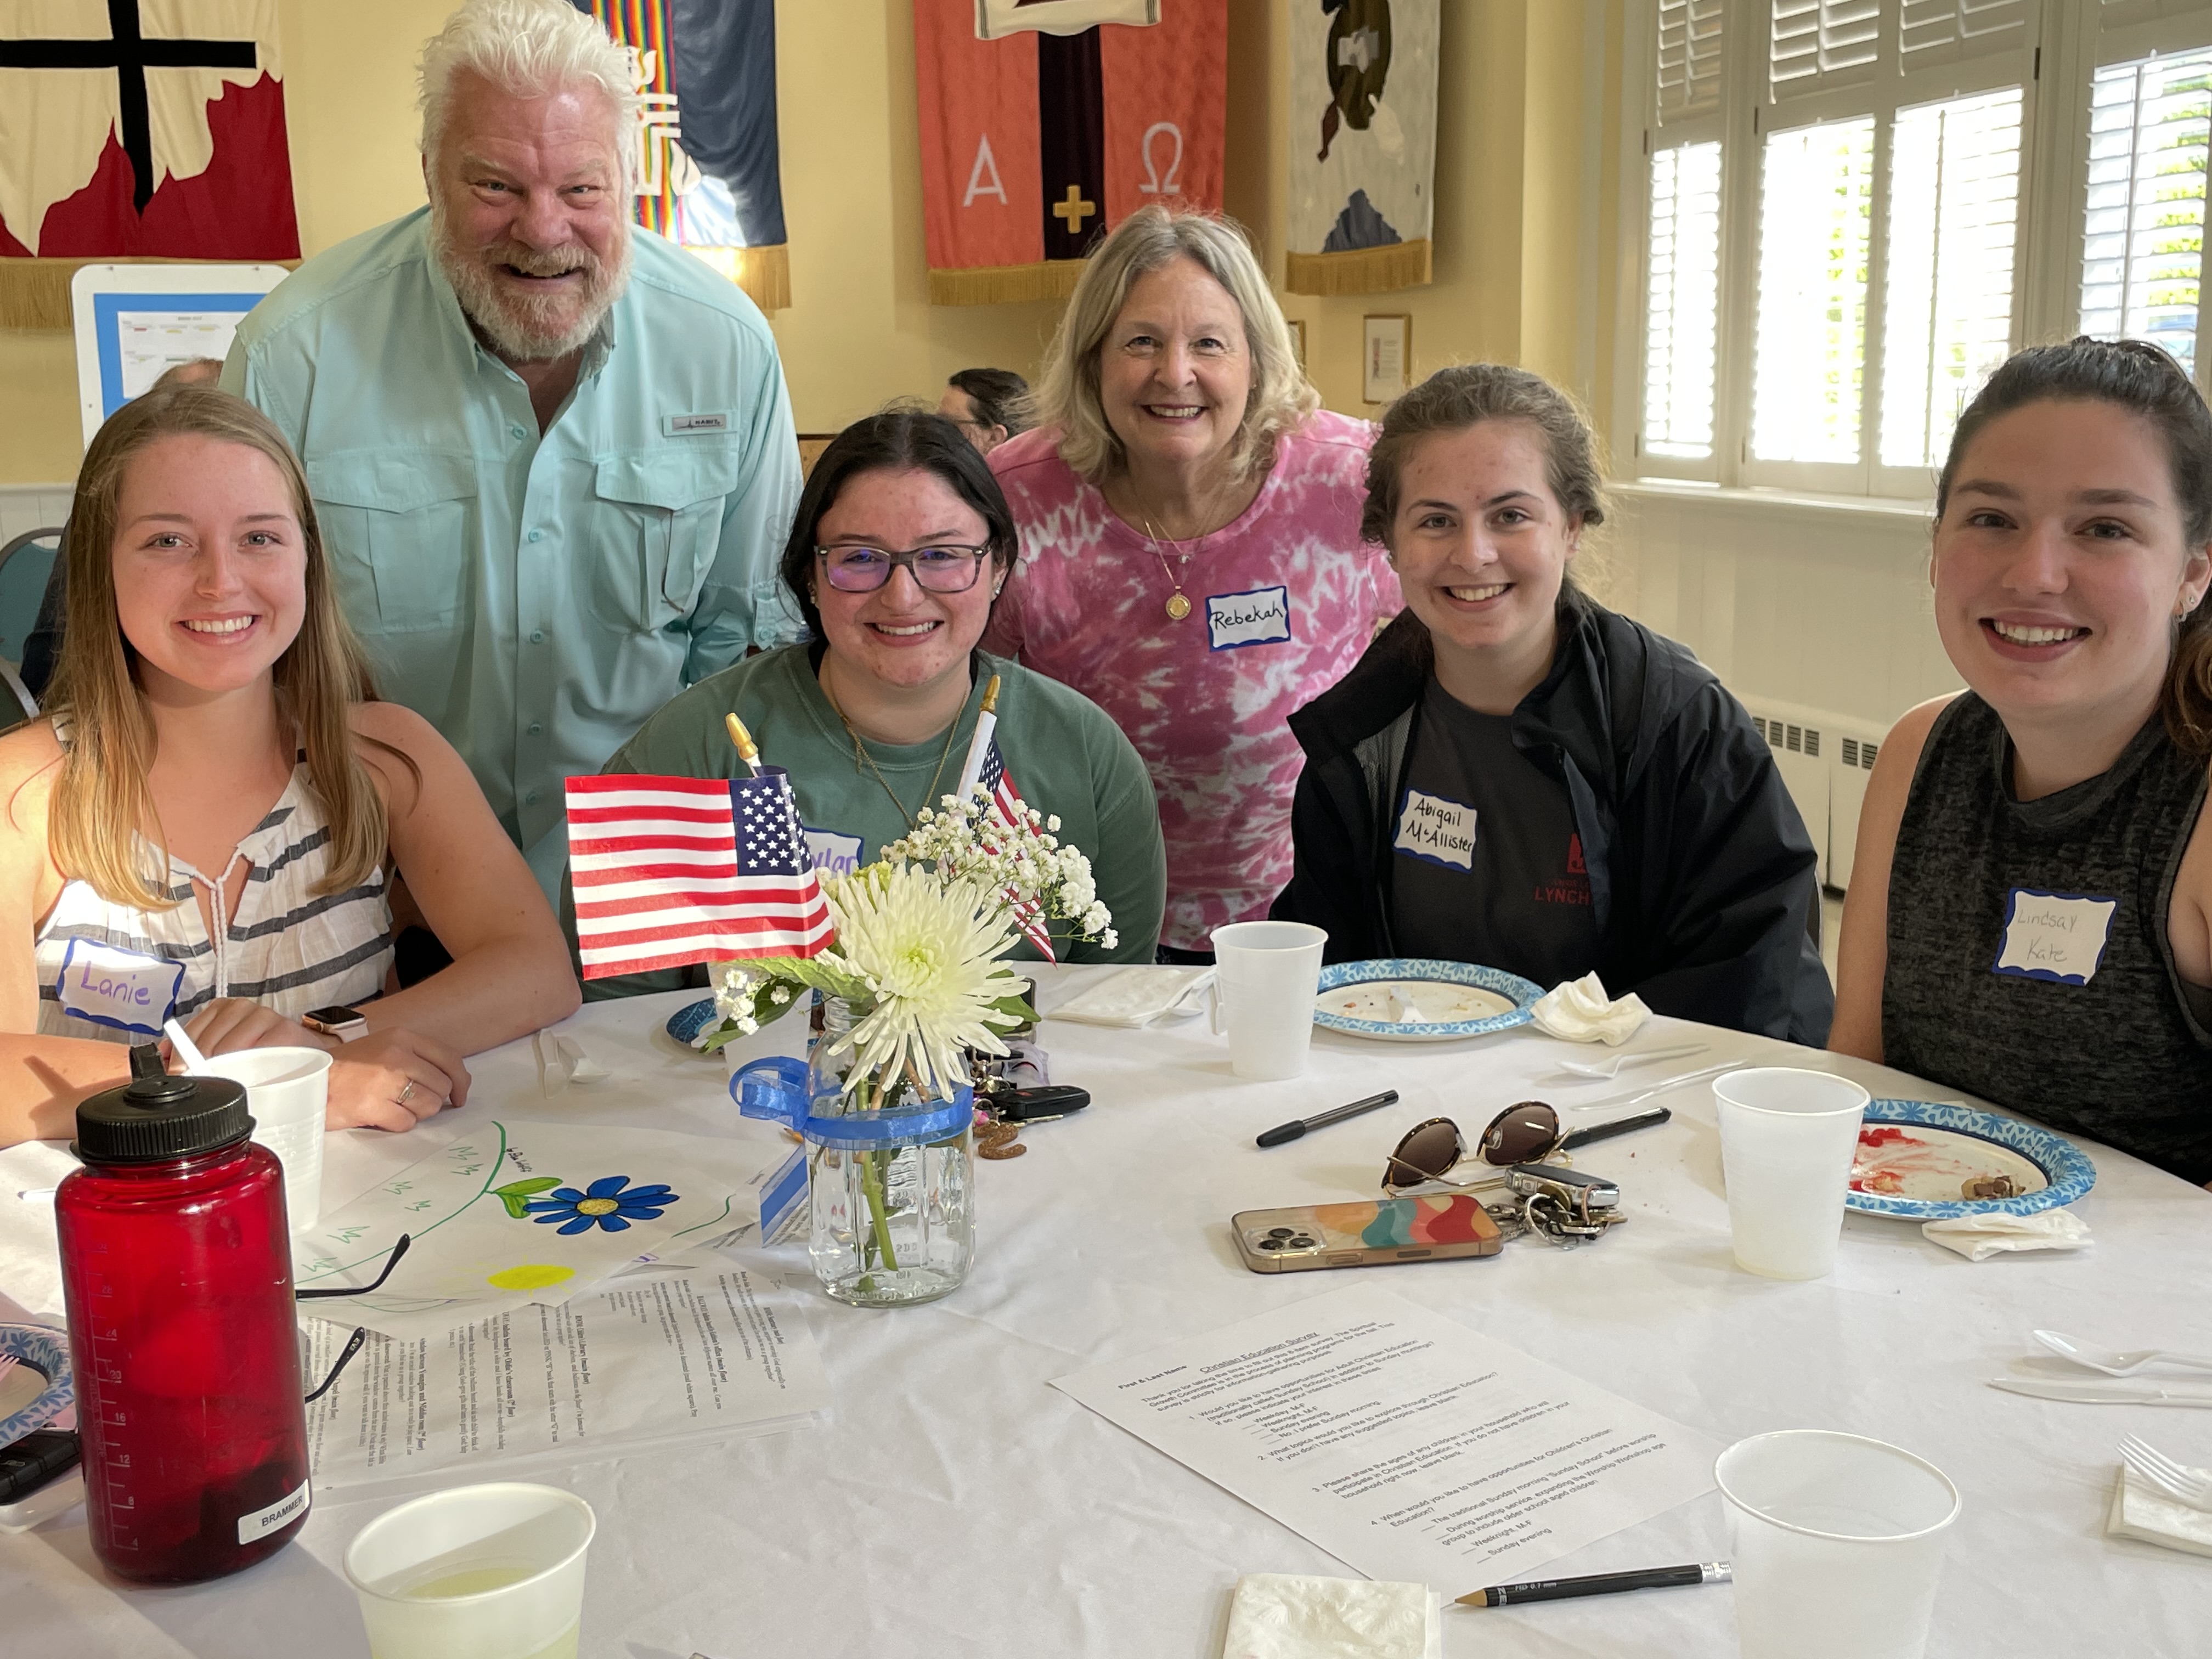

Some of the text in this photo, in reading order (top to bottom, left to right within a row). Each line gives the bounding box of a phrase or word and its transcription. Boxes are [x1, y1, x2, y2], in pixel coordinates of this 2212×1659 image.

[1138, 121, 1184, 194] Ω
[1212, 605, 1285, 630] Rebekah
[1414, 797, 1461, 827] Abigail
[1406, 820, 1472, 853] McAllister
[2017, 909, 2078, 933] Lindsay
[2026, 935, 2068, 962] Kate
[80, 961, 151, 1006] Lanie
[1199, 1331, 1321, 1374] Christian Education Survey
[1118, 1381, 1138, 1390] First
[1144, 1373, 1165, 1381] Last
[115, 1413, 126, 1423] 16
[119, 1454, 131, 1464] 12
[1379, 1510, 1406, 1521] When
[1404, 1499, 1430, 1511] would
[1429, 1494, 1446, 1503] you
[1466, 1477, 1488, 1487] have
[1488, 1459, 1536, 1479] opportunities
[1544, 1441, 1582, 1457] Children's
[1580, 1429, 1613, 1442] Christian
[1448, 1500, 1488, 1517] traditional
[1486, 1488, 1517, 1503] Sunday
[1516, 1476, 1549, 1491] morning
[1603, 1444, 1629, 1455] before
[1628, 1434, 1657, 1446] worship
[128, 1497, 134, 1506] 8
[1446, 1520, 1476, 1533] During
[1473, 1508, 1505, 1522] worship
[1534, 1480, 1575, 1497] expanding
[1583, 1463, 1617, 1477] Worship
[1613, 1448, 1652, 1464] Workshop
[261, 1495, 304, 1527] BRAMMER
[1389, 1506, 1435, 1527] Education?
[1441, 1533, 1466, 1546] group
[1473, 1519, 1504, 1532] include
[1503, 1510, 1523, 1521] older
[1523, 1498, 1550, 1511] school
[1549, 1490, 1570, 1501] aged
[1568, 1480, 1599, 1493] children
[1487, 1528, 1553, 1556] Sunday evening
